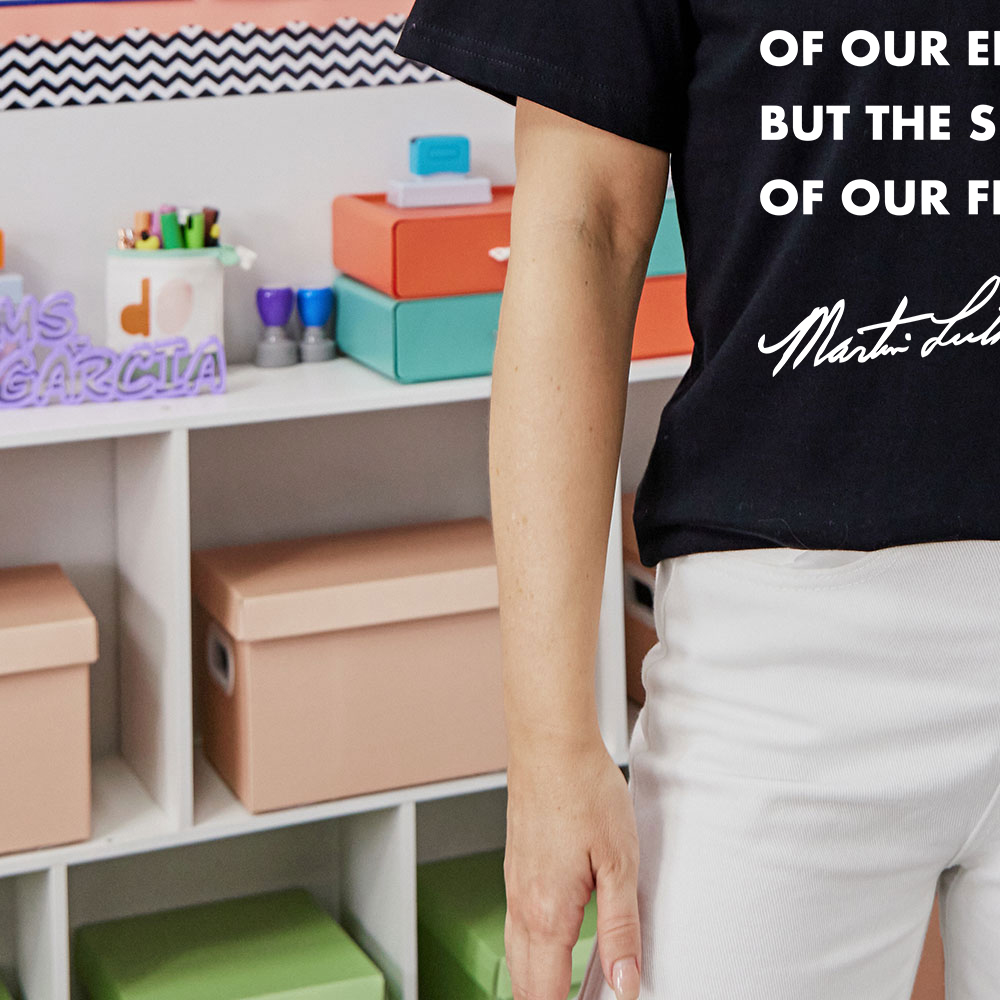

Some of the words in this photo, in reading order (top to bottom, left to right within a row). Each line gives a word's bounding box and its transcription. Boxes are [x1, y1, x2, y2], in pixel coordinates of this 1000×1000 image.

[760, 30, 823, 66] OF
[842, 30, 950, 66] OUR
[762, 106, 850, 141] BUT
[866, 106, 950, 140] THE
[760, 179, 823, 215] OF
[842, 179, 950, 215] OUR
[758, 296, 934, 377] Martin
